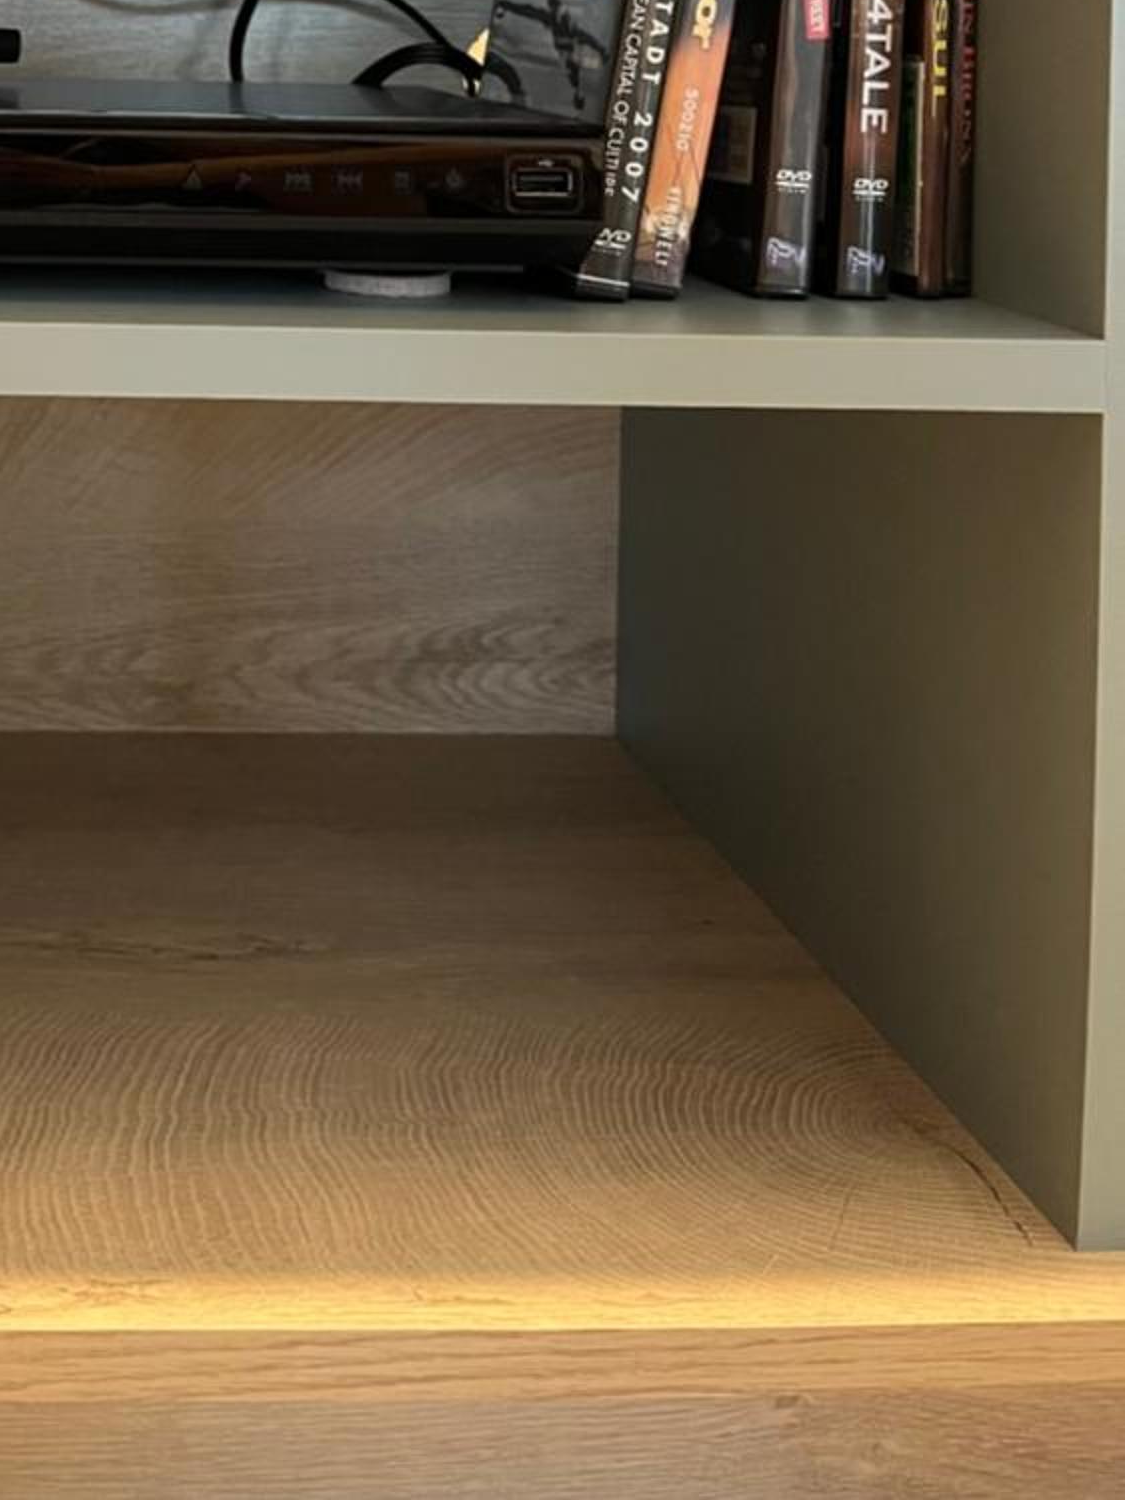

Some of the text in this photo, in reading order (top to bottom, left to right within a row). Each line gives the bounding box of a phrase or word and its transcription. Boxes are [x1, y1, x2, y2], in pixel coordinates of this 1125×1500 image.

[616, 32, 642, 95] CAPITAL
[612, 100, 630, 124] OF
[621, 112, 653, 203] 2007
[776, 169, 812, 182] DVD
